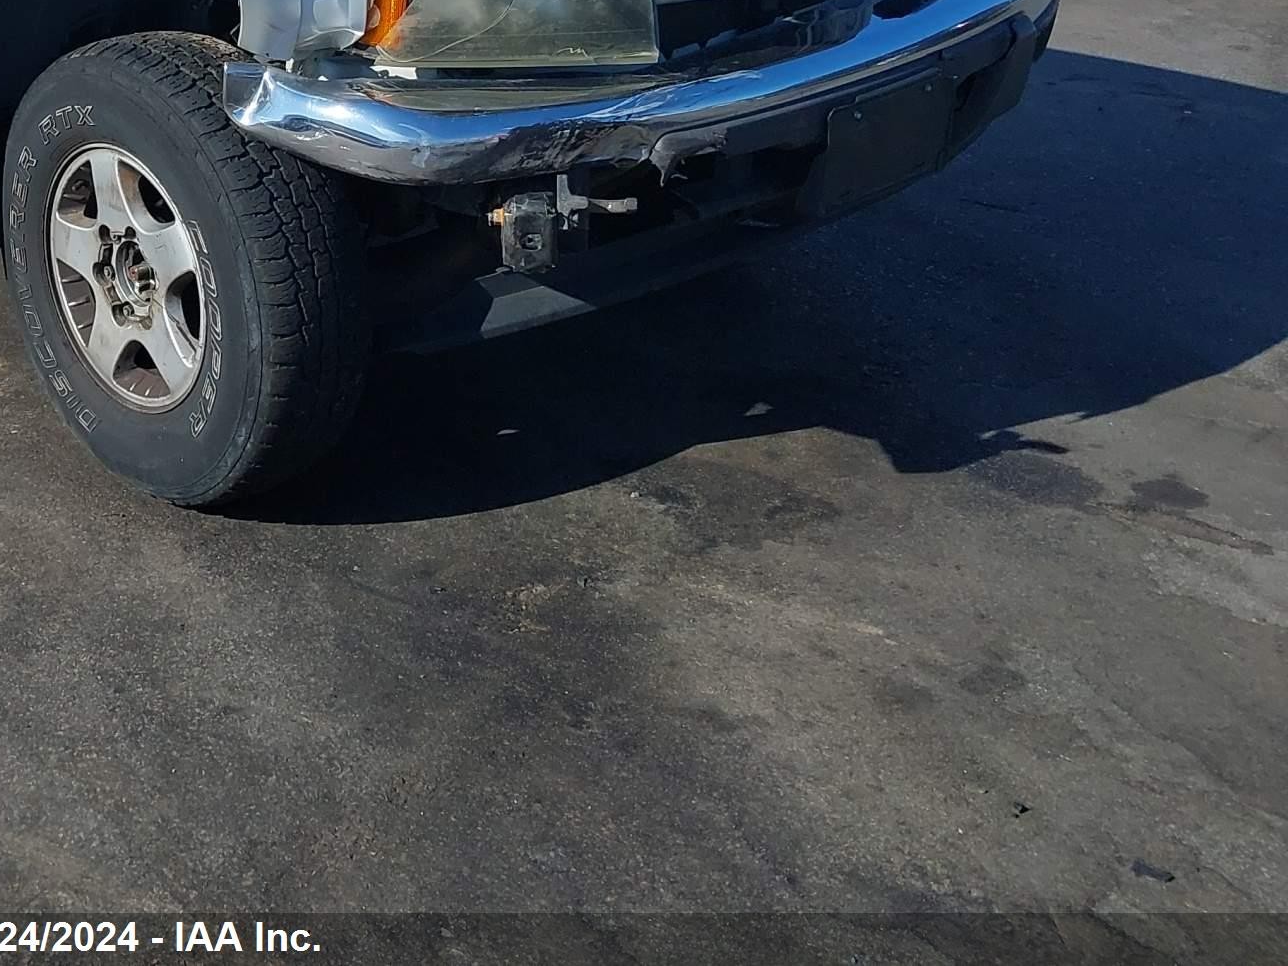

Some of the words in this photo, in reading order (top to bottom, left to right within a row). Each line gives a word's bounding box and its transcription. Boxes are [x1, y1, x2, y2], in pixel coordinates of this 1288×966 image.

[38, 105, 97, 146] RTX
[10, 145, 97, 433] DISCOVERER
[186, 220, 222, 438] COOPER
